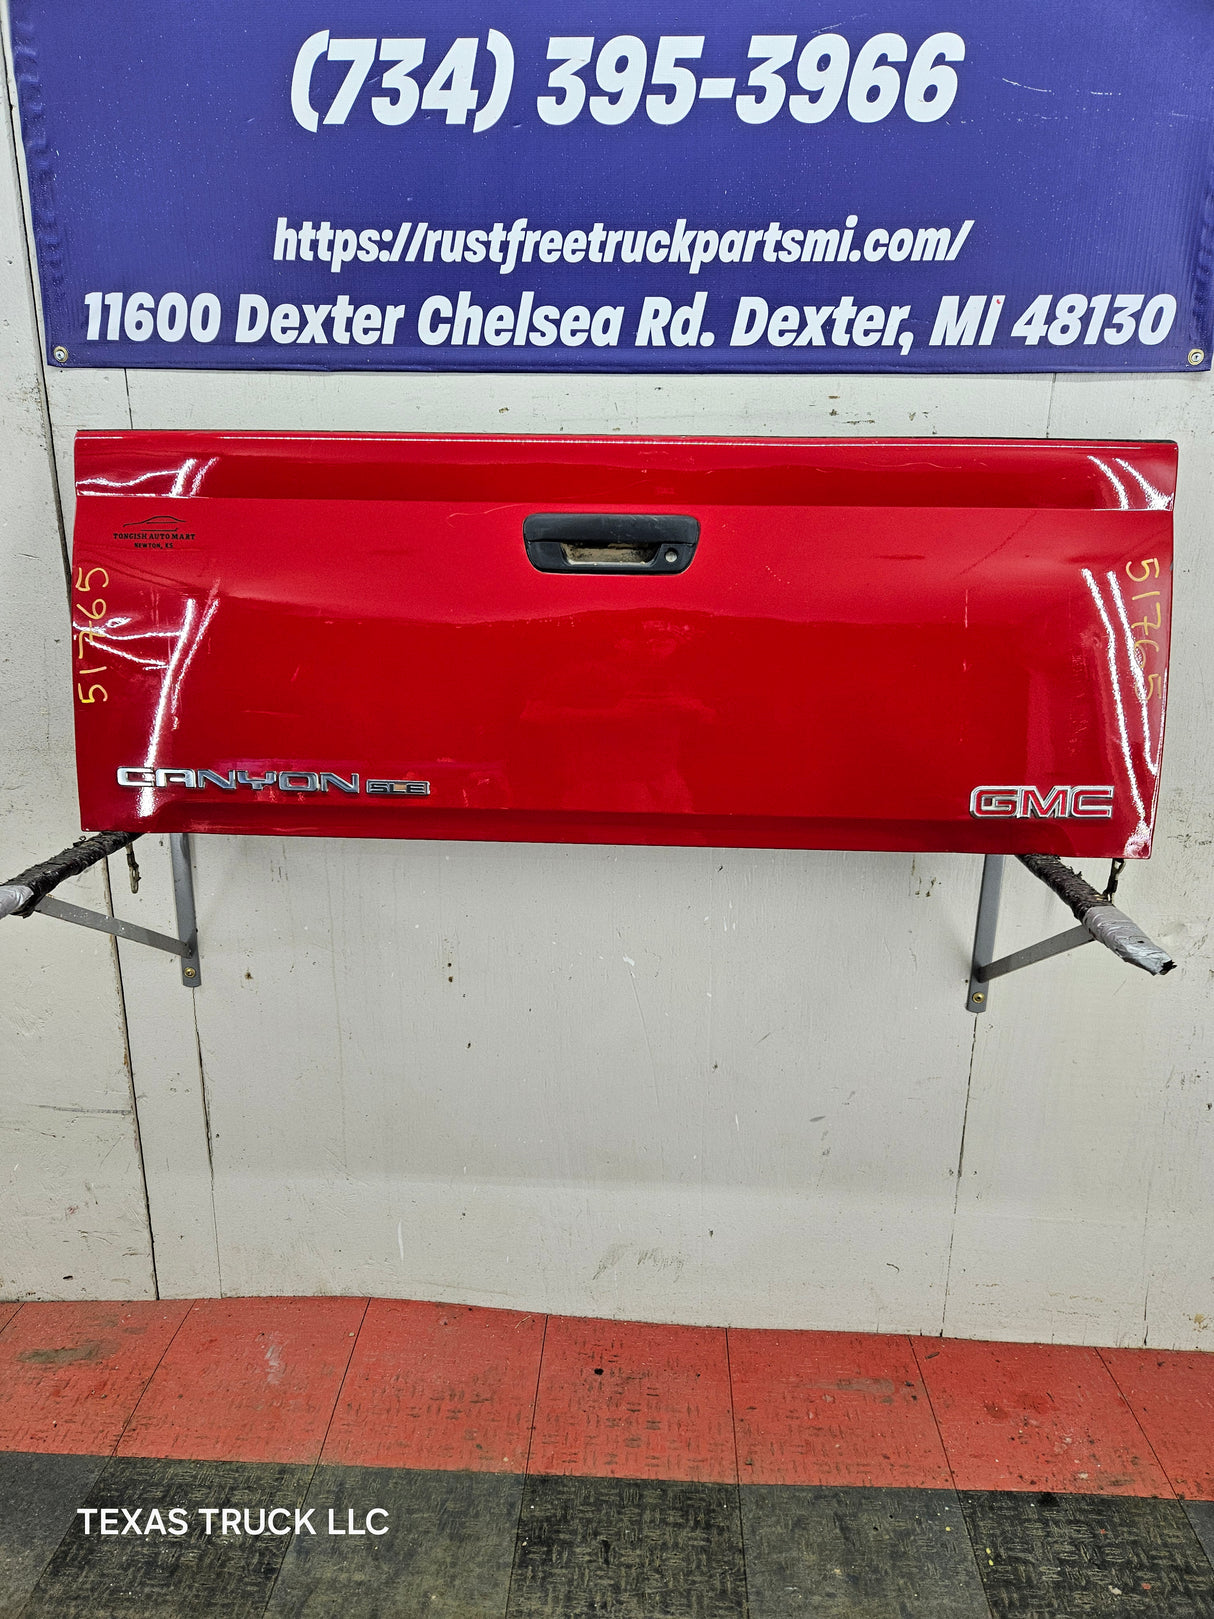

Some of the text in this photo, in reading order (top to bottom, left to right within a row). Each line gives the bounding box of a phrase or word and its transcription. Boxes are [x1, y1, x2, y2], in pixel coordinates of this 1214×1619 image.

[290, 29, 966, 133] (734) 395-3966
[273, 214, 975, 275] https://rustfreetruckpartsmi.com/
[84, 290, 1177, 356] 11600 Dexter Chelsea Rd. Dexter, MI 48130
[113, 532, 147, 540] TONGISH
[172, 533, 196, 541] MART
[134, 542, 163, 550] NEWTON,
[75, 566, 110, 704] 51765
[116, 766, 430, 796] CANYON SLE
[969, 785, 1115, 819] GMC
